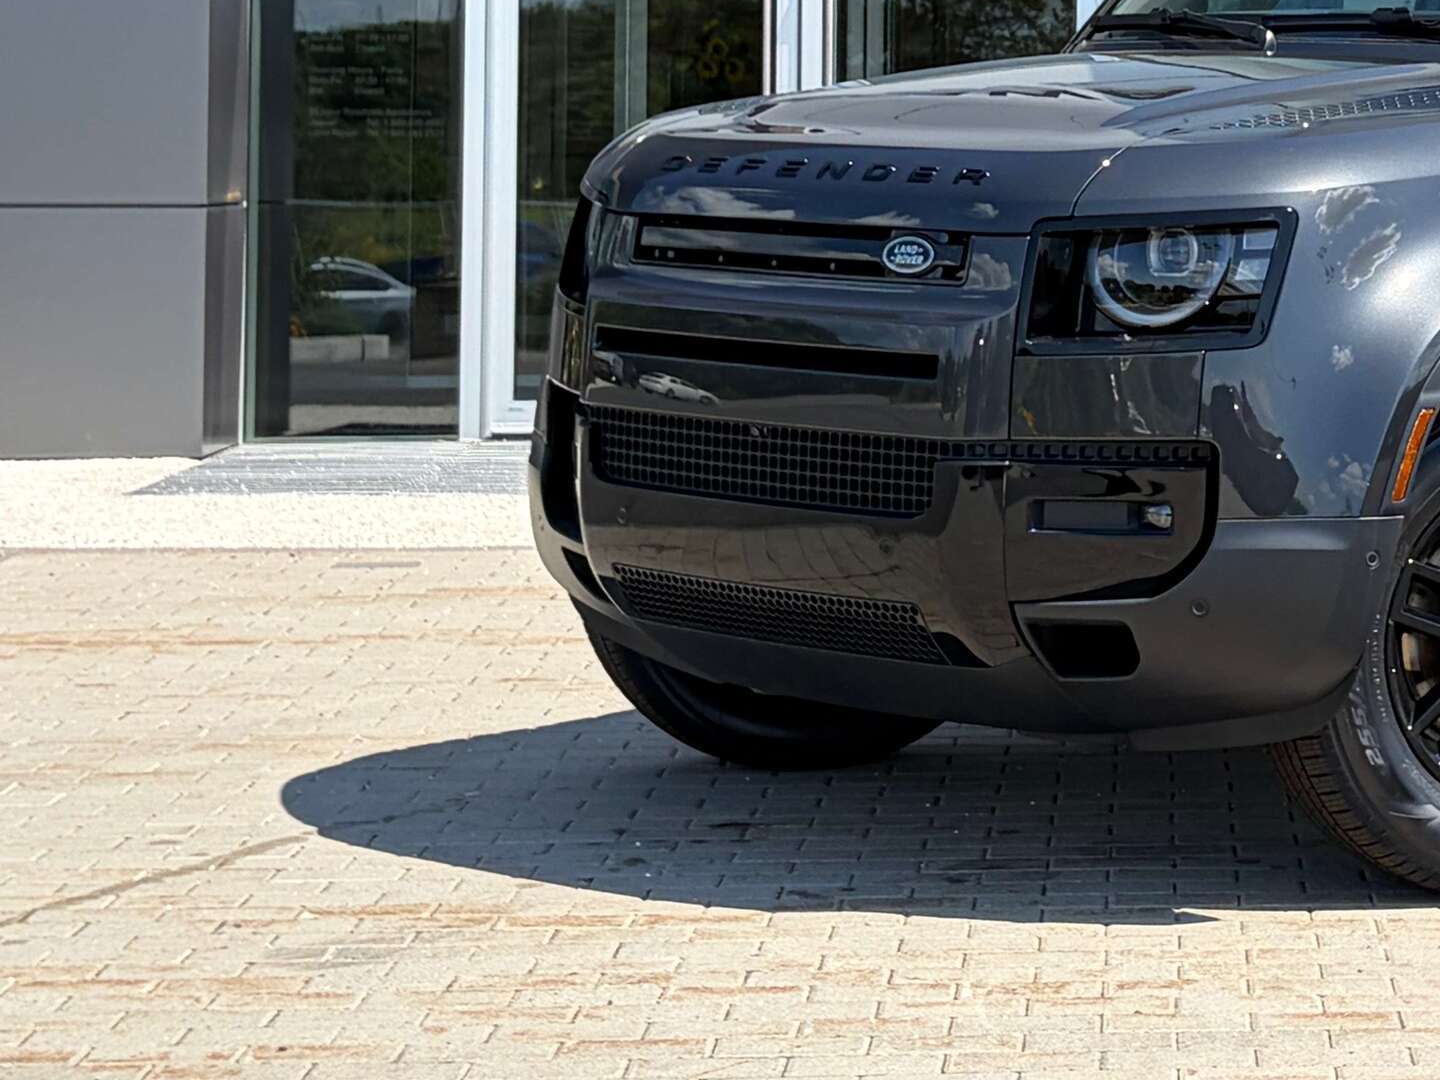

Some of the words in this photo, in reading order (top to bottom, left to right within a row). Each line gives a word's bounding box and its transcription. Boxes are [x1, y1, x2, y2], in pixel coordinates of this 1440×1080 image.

[660, 155, 991, 187] DEFENDER
[894, 244, 919, 255] LAND
[895, 255, 924, 265] ROVER
